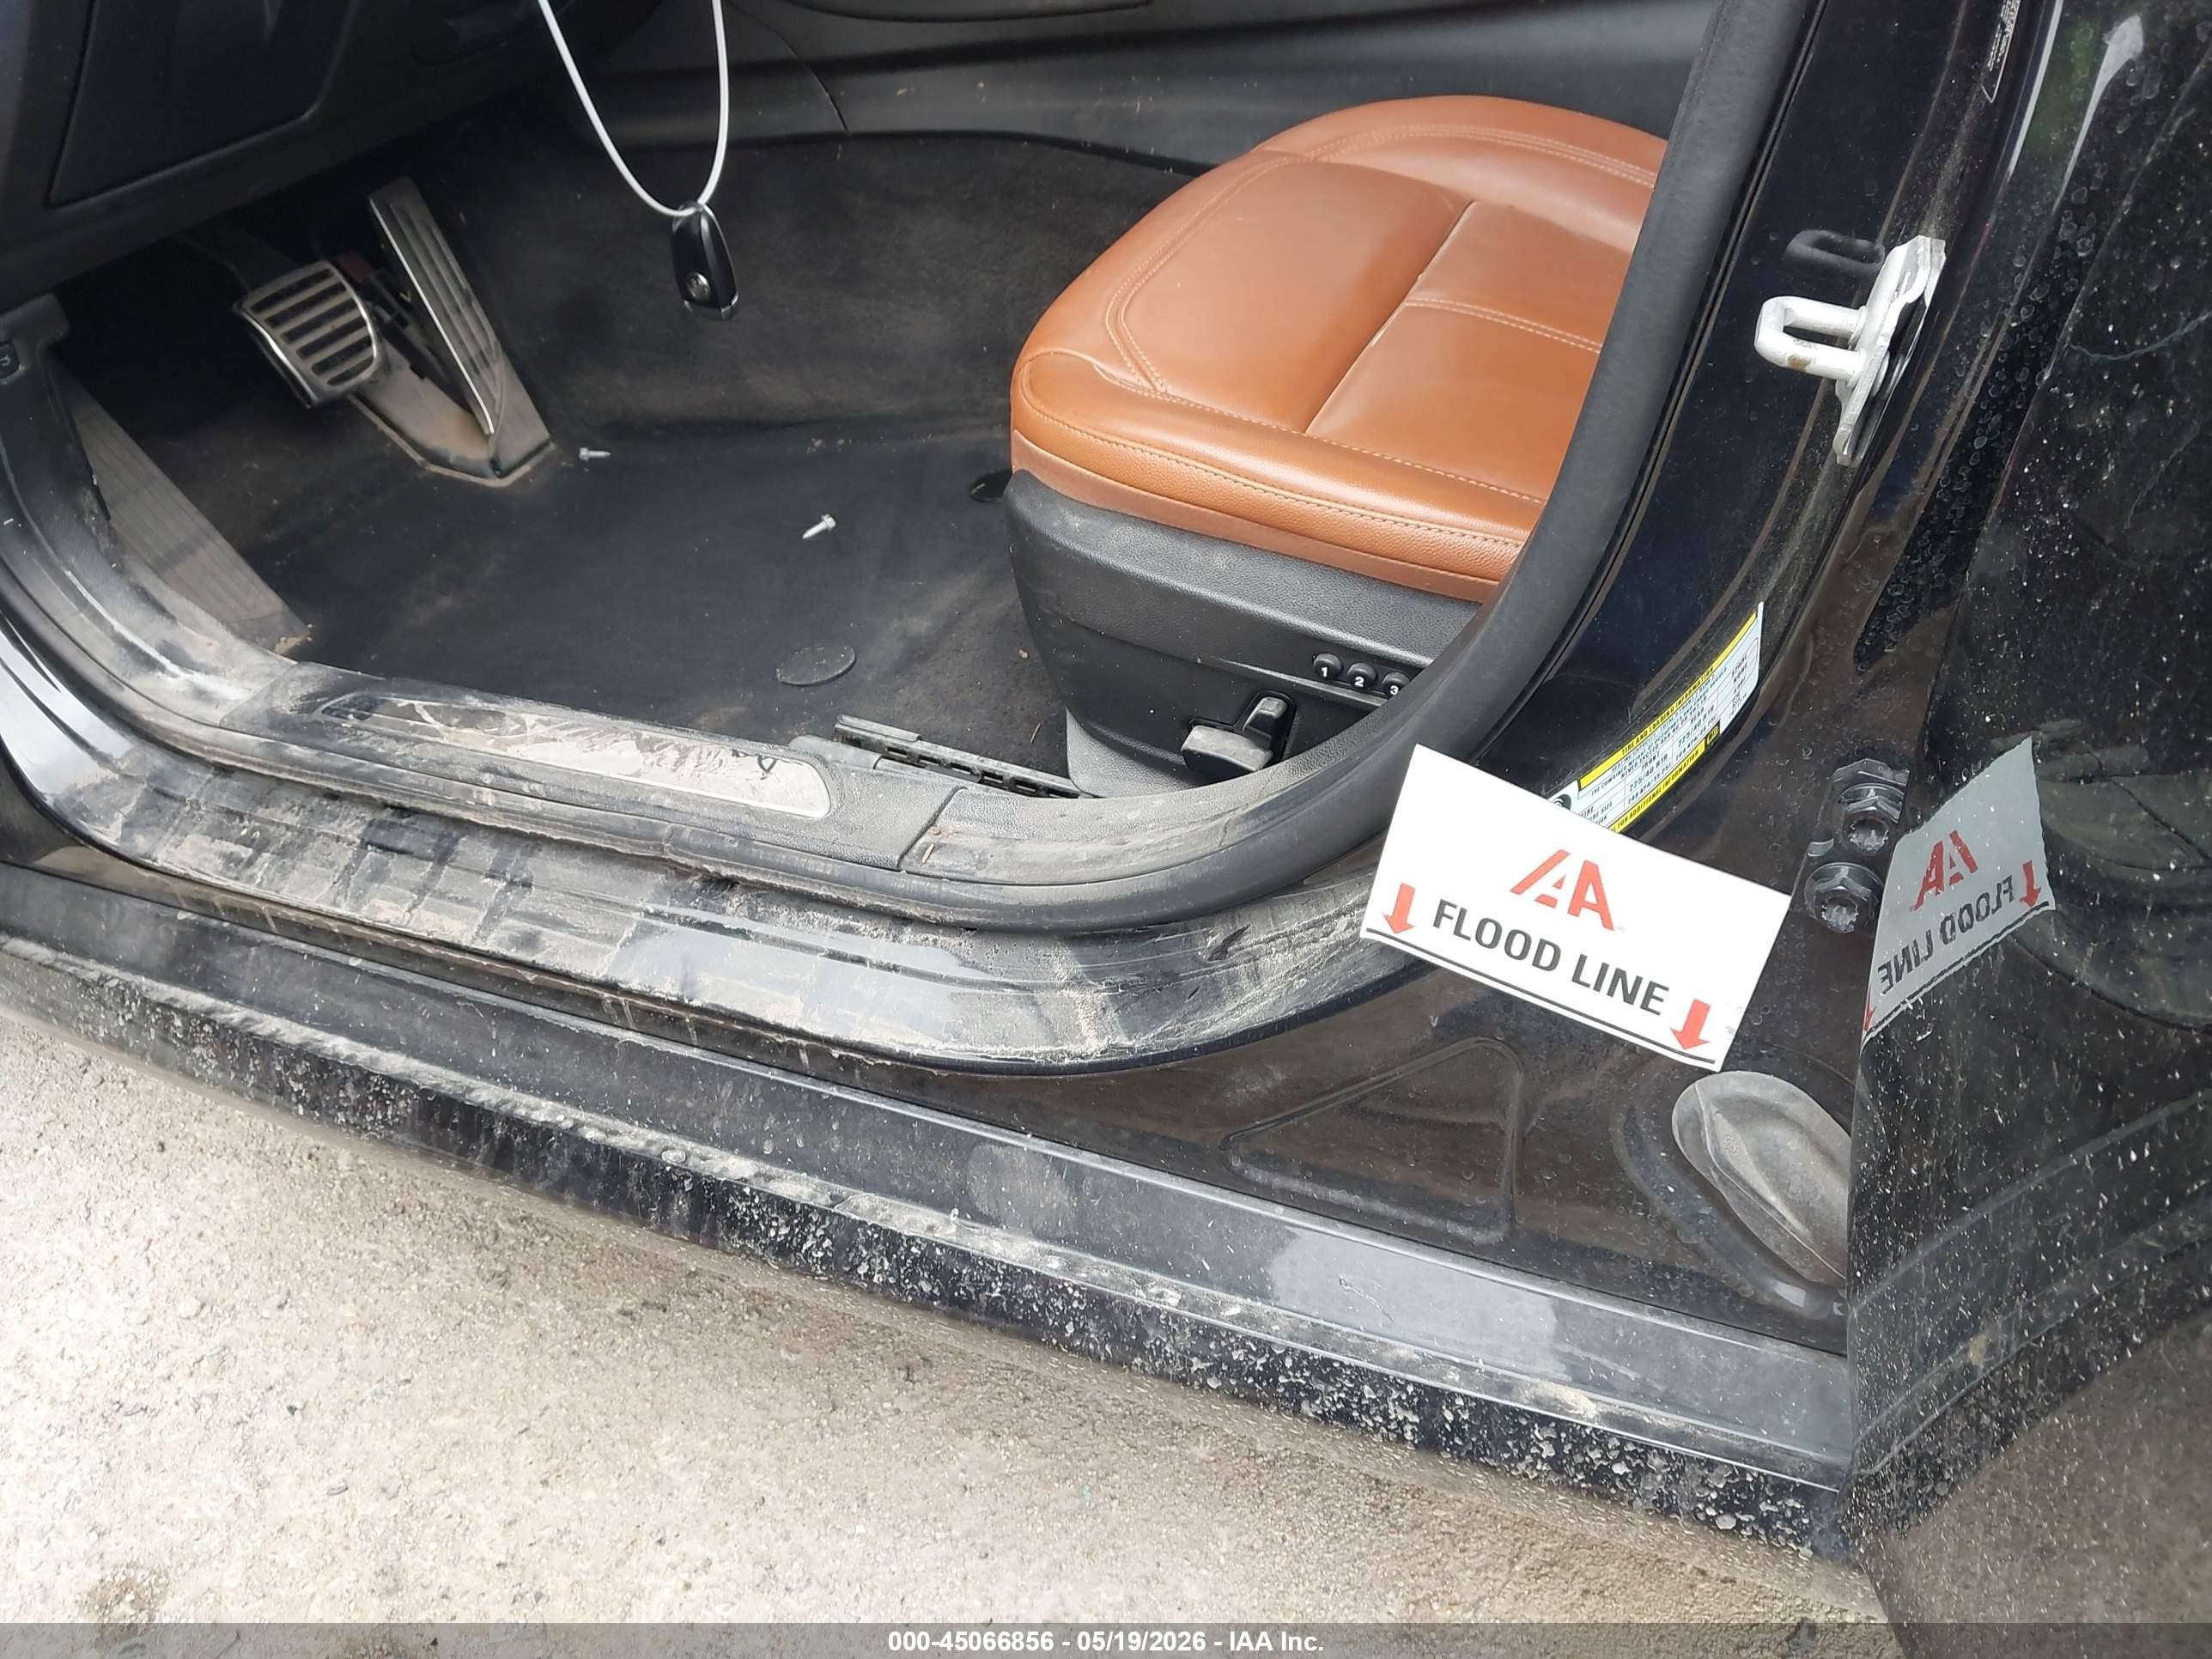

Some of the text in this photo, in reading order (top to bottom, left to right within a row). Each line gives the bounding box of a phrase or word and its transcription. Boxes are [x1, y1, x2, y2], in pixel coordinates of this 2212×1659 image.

[1321, 666, 1328, 678] 1
[1354, 676, 1364, 688] 2
[1389, 685, 1400, 696] 3
[1621, 742, 1634, 756] TIRE
[1635, 731, 1648, 744] AND
[1649, 706, 1674, 732] LOADING
[1676, 665, 1714, 708] INFORMATION
[1617, 748, 1699, 830] FOR ADDITIONAL INFORMATION
[1601, 800, 1613, 814] SIZE
[1432, 898, 1670, 1017] FLOOD LINE
